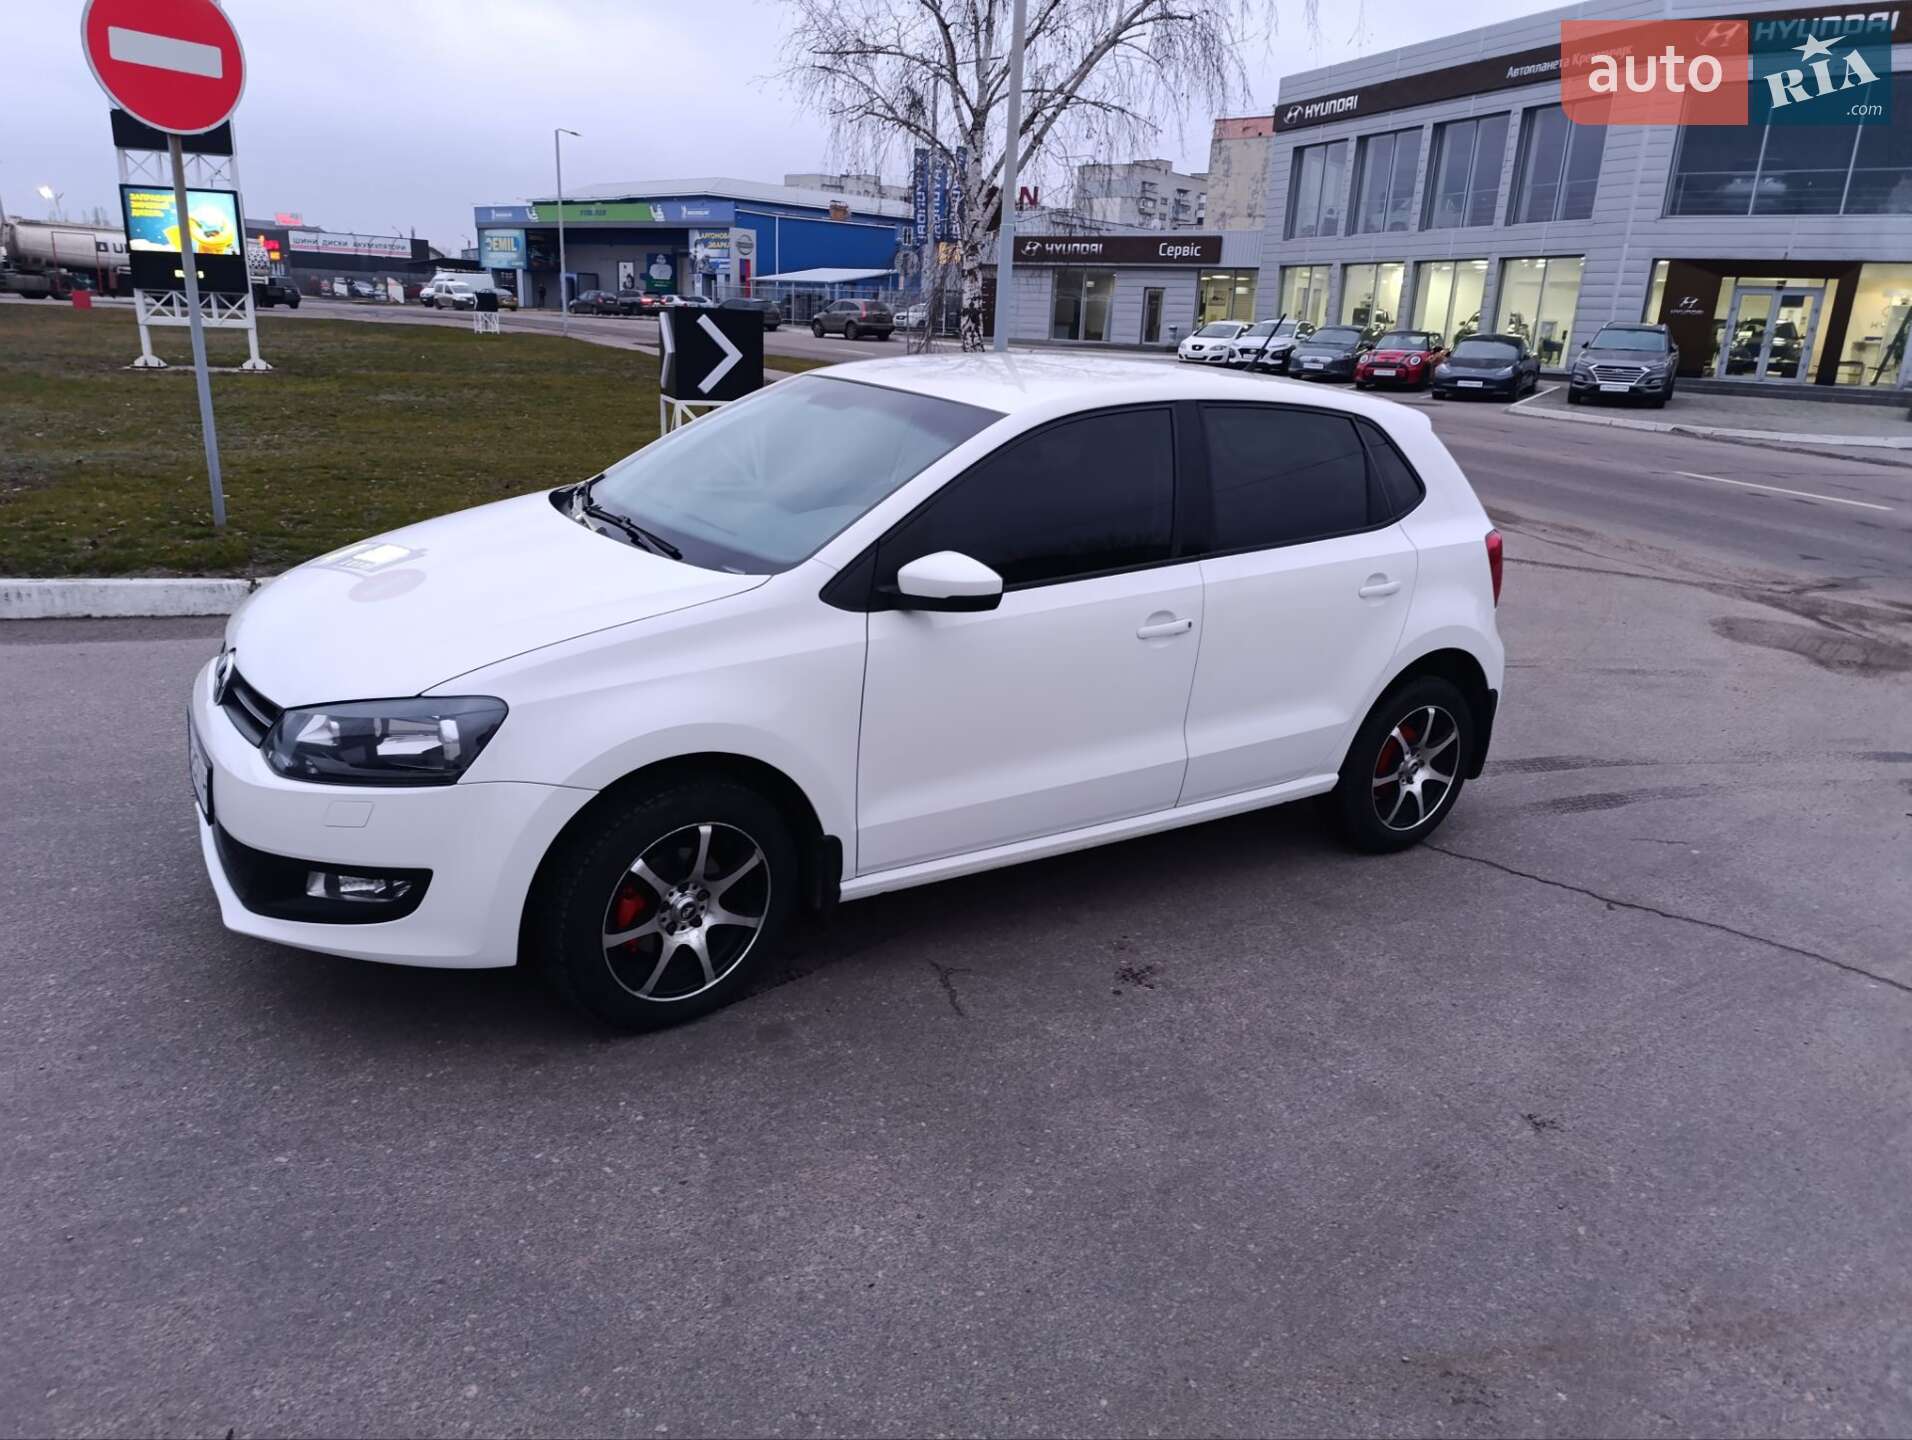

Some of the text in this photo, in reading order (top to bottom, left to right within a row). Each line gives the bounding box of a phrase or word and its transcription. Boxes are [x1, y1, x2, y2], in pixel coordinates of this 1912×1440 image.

[1755, 10, 1900, 41] HYUNDAI
[1304, 95, 1359, 119] HYUNDAI
[1045, 243, 1103, 255] HYUNDAI
[1158, 242, 1202, 259] Сервіс
